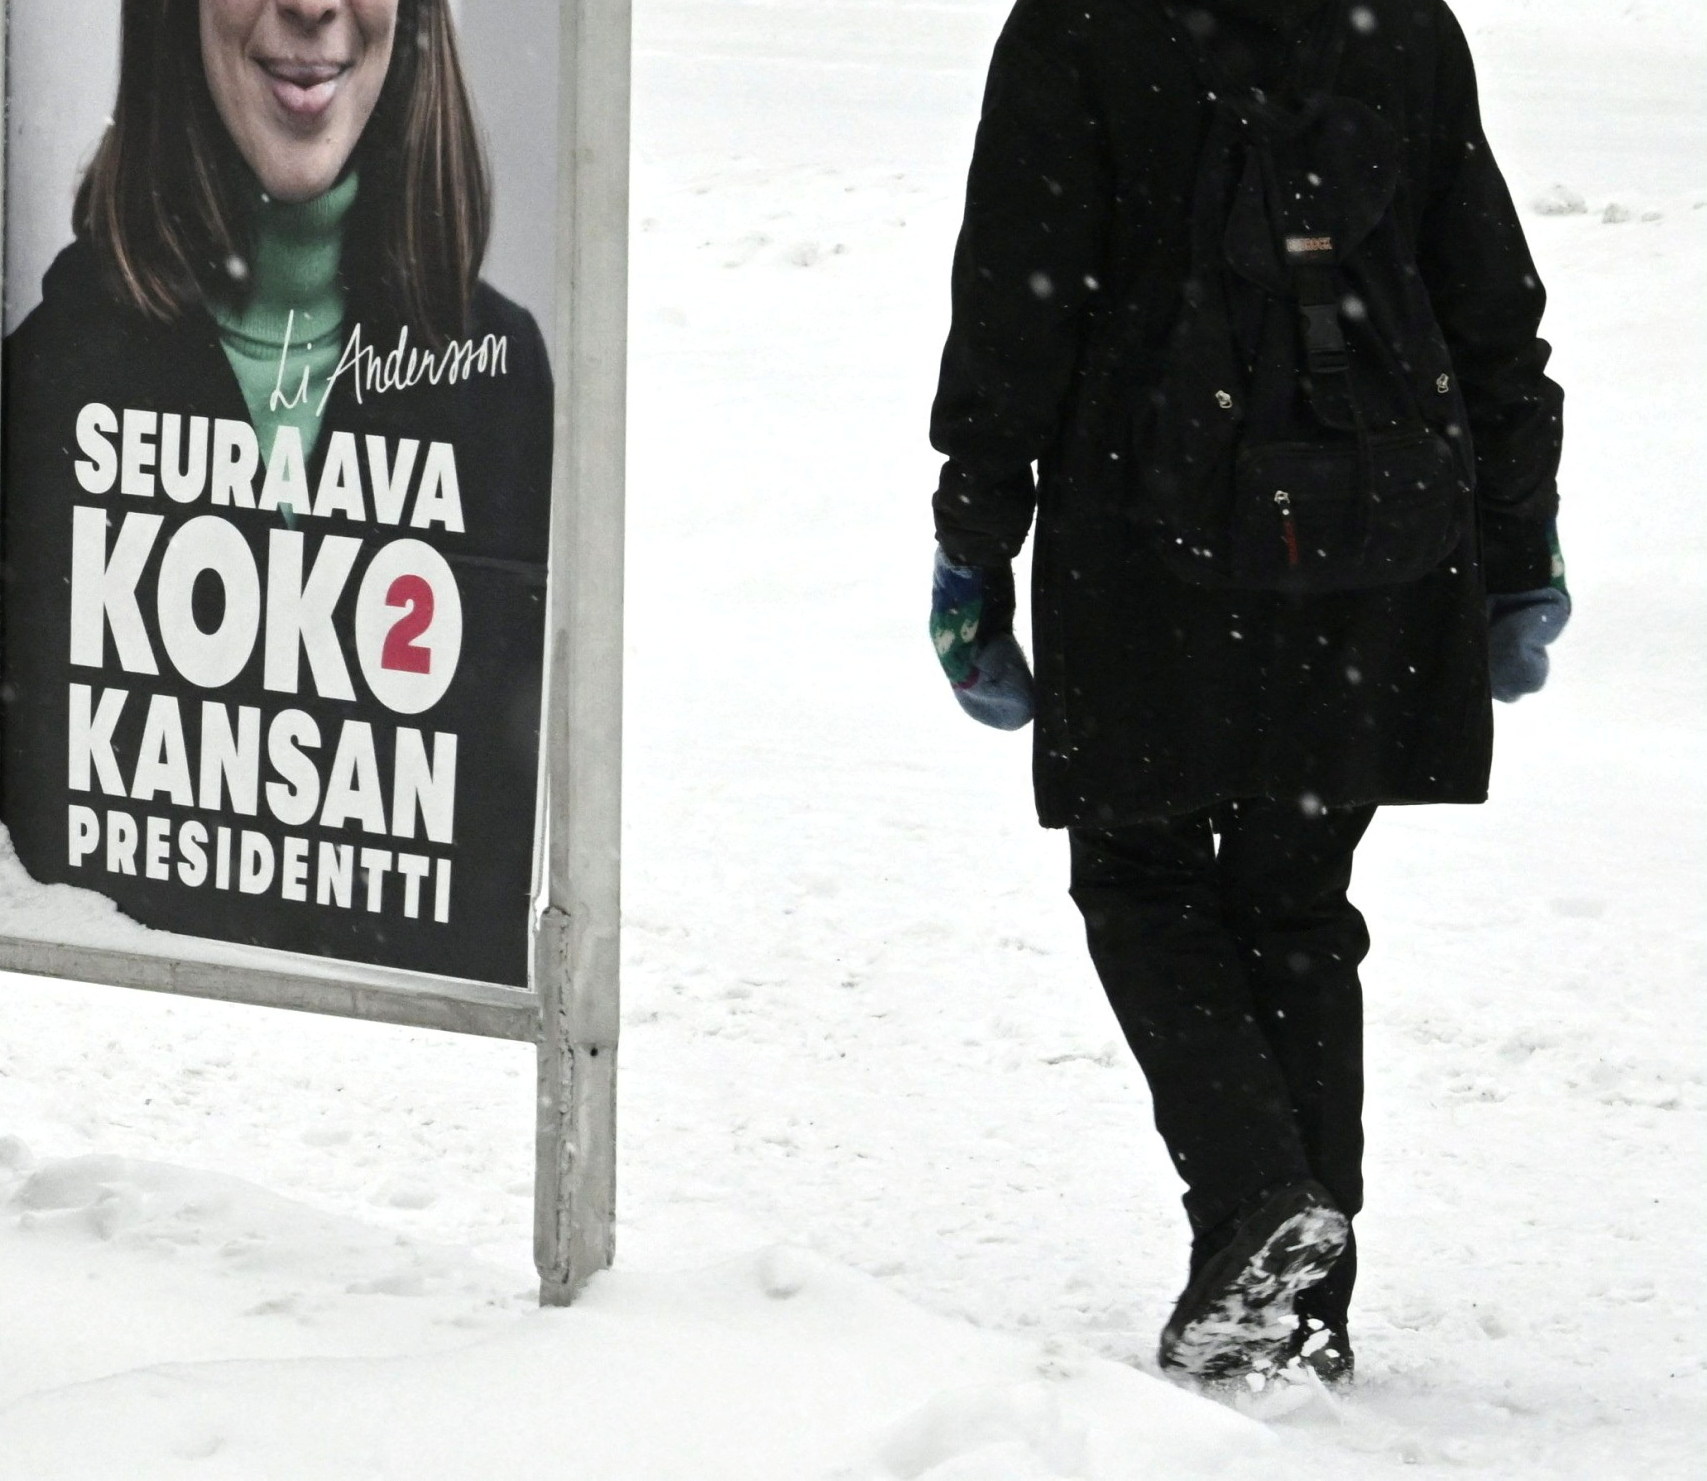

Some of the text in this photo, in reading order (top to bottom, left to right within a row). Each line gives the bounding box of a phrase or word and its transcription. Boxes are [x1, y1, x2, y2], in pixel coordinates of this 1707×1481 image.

[270, 309, 508, 417] Li Andersson
[74, 402, 465, 534] SEURAAVA
[380, 574, 435, 675] 2
[68, 683, 457, 844] KANSAN
[68, 804, 452, 923] PRESIDENTTI
